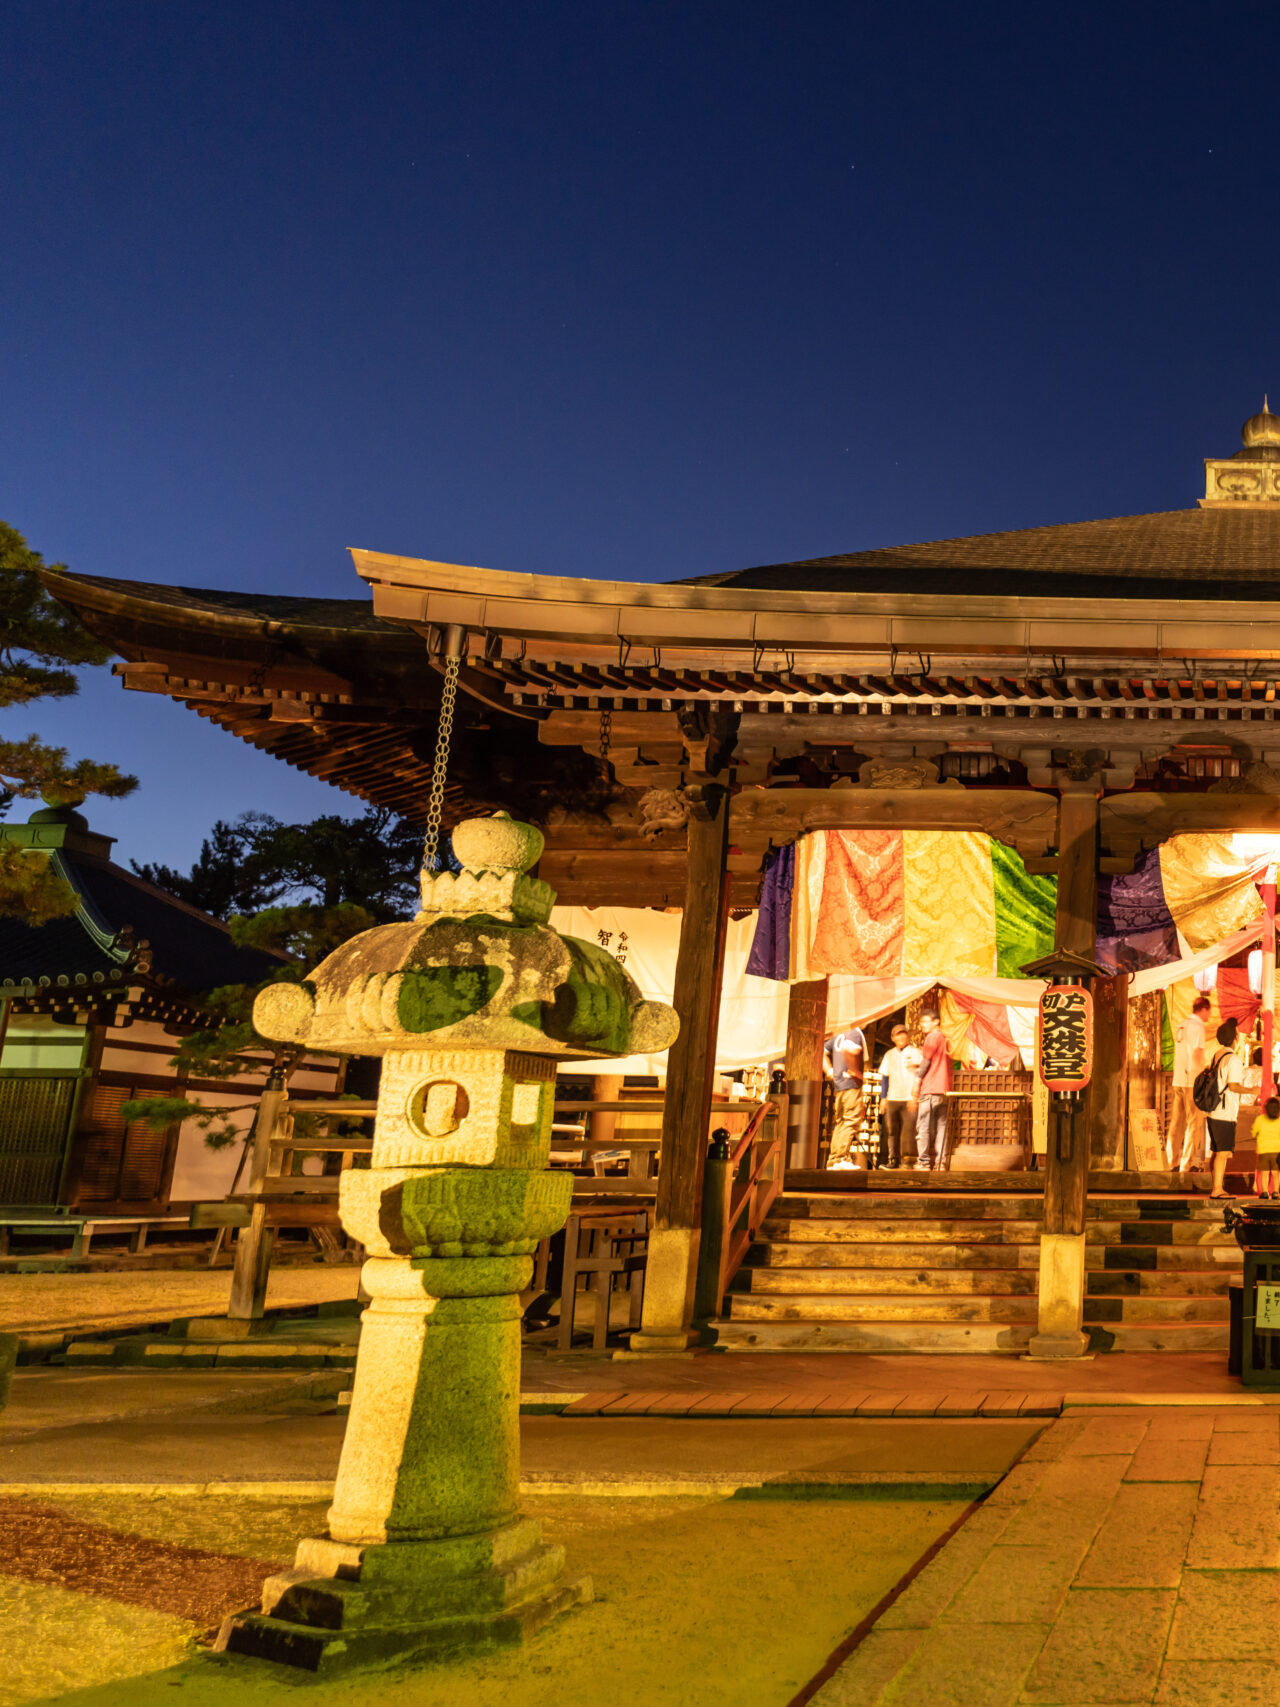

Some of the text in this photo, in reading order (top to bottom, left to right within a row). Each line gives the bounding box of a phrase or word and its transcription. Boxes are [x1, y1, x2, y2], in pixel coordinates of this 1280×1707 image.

[597, 929, 613, 946] 智
[1041, 1007, 1088, 1080] 文殊堂
